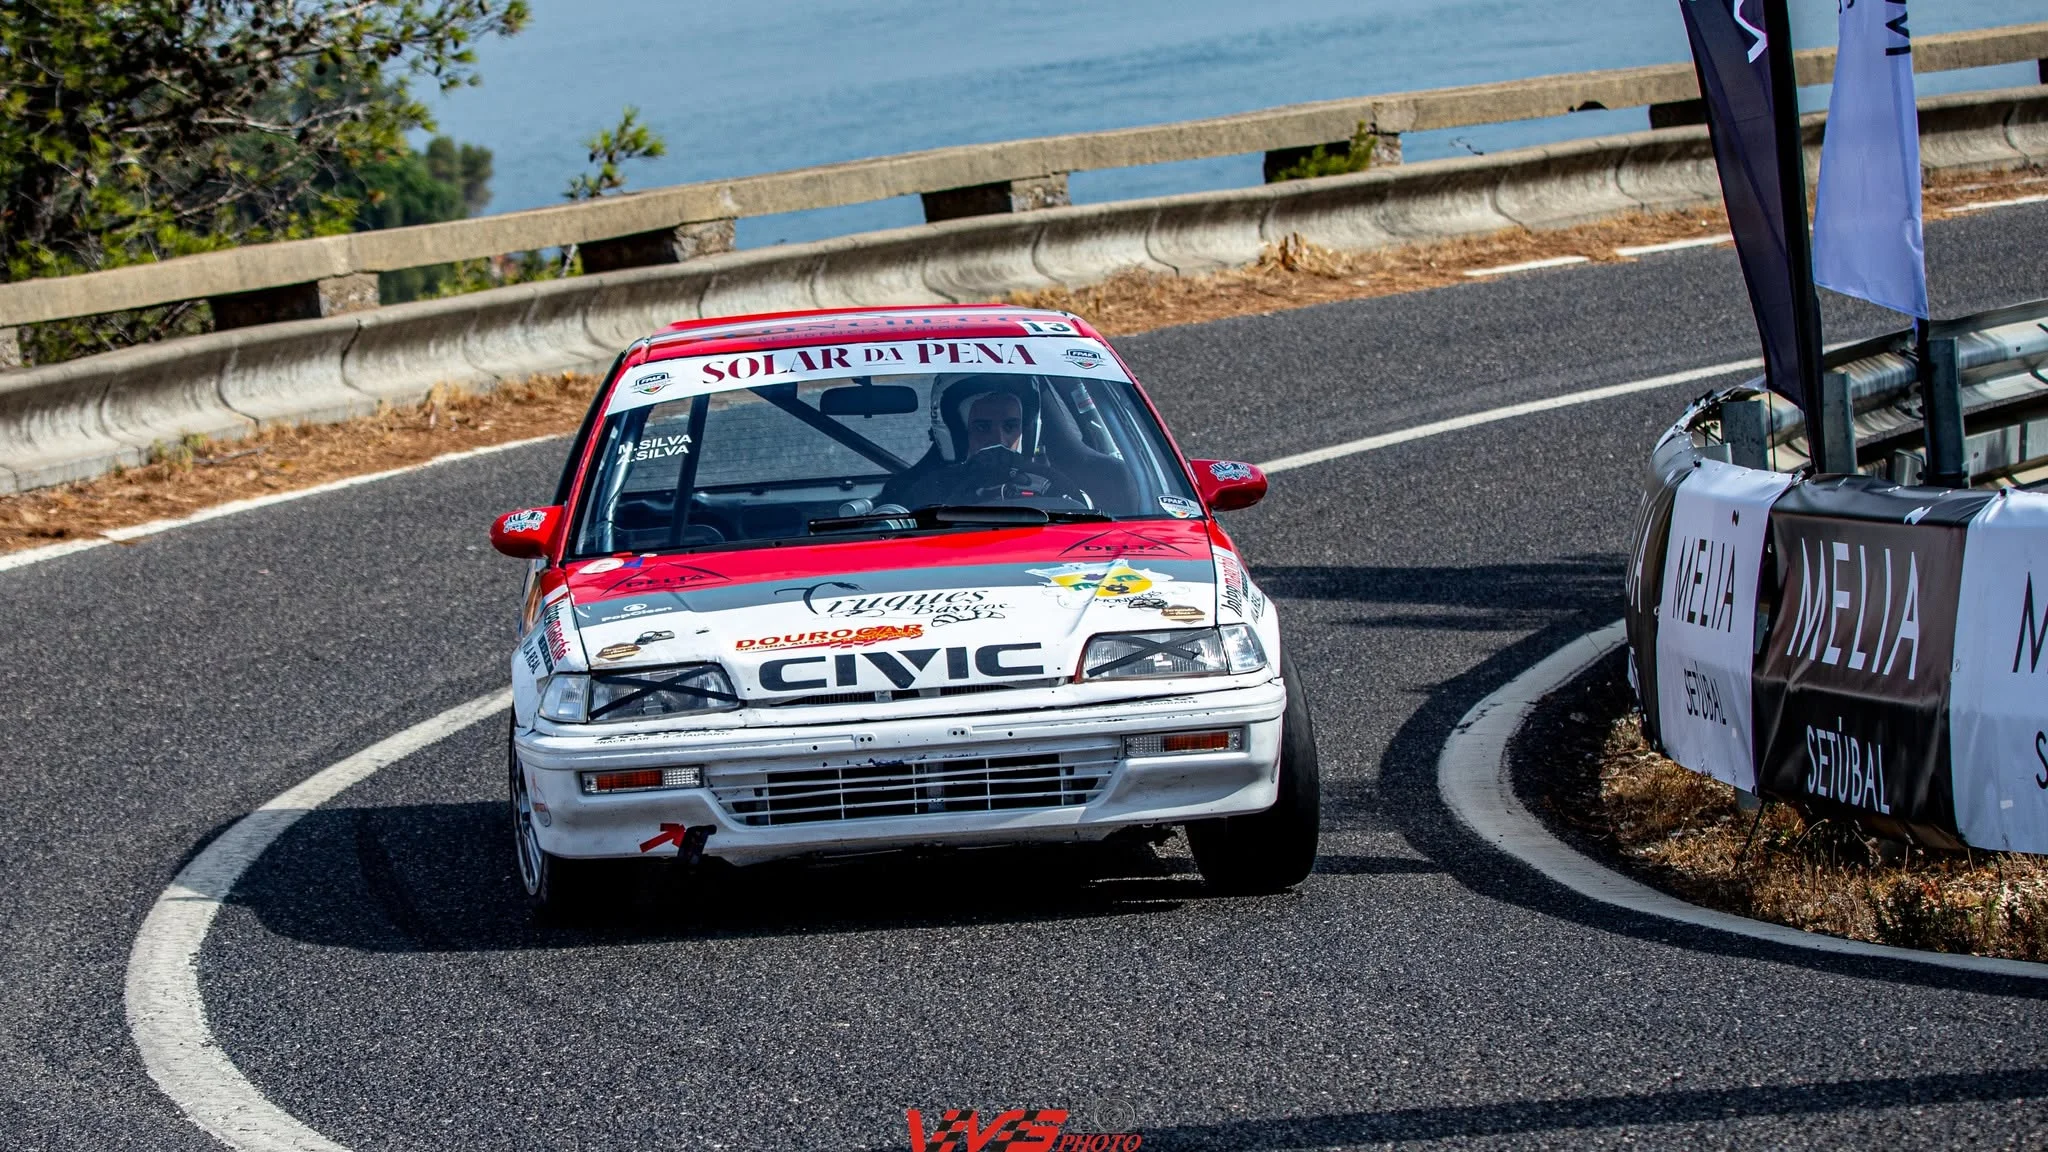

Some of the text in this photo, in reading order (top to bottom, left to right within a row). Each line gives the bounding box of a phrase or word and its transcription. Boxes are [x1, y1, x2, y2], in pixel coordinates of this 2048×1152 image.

[1023, 321, 1071, 333] 13
[702, 342, 1037, 385] SOLAR DA PENA
[616, 445, 690, 466] A.SILVA
[1083, 544, 1167, 552] DELTA
[625, 574, 705, 588] DELTA
[601, 606, 673, 622] PopClean
[736, 624, 924, 649] DOUROCAR
[759, 641, 1045, 692] CIVIC
[1684, 660, 1727, 726] SETÚBAL
[1806, 716, 1890, 815] SETÚBAL
